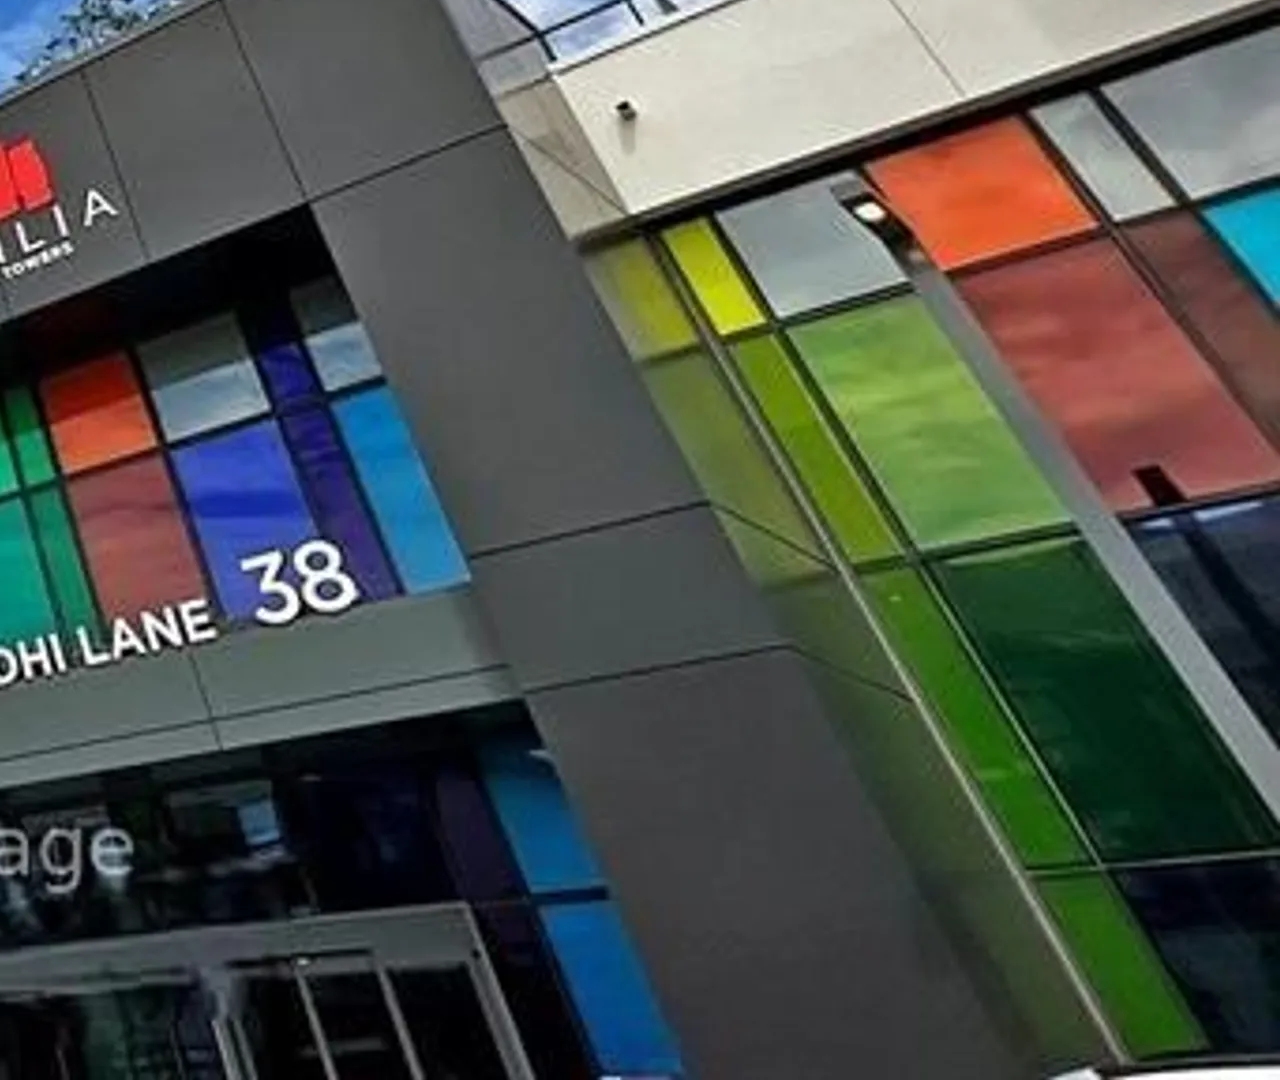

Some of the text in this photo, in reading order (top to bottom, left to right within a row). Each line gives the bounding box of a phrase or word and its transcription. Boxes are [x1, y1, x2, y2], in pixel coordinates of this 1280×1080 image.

[1, 241, 75, 279] TOWERS
[76, 599, 218, 664] LANE
[241, 540, 360, 625] 38
